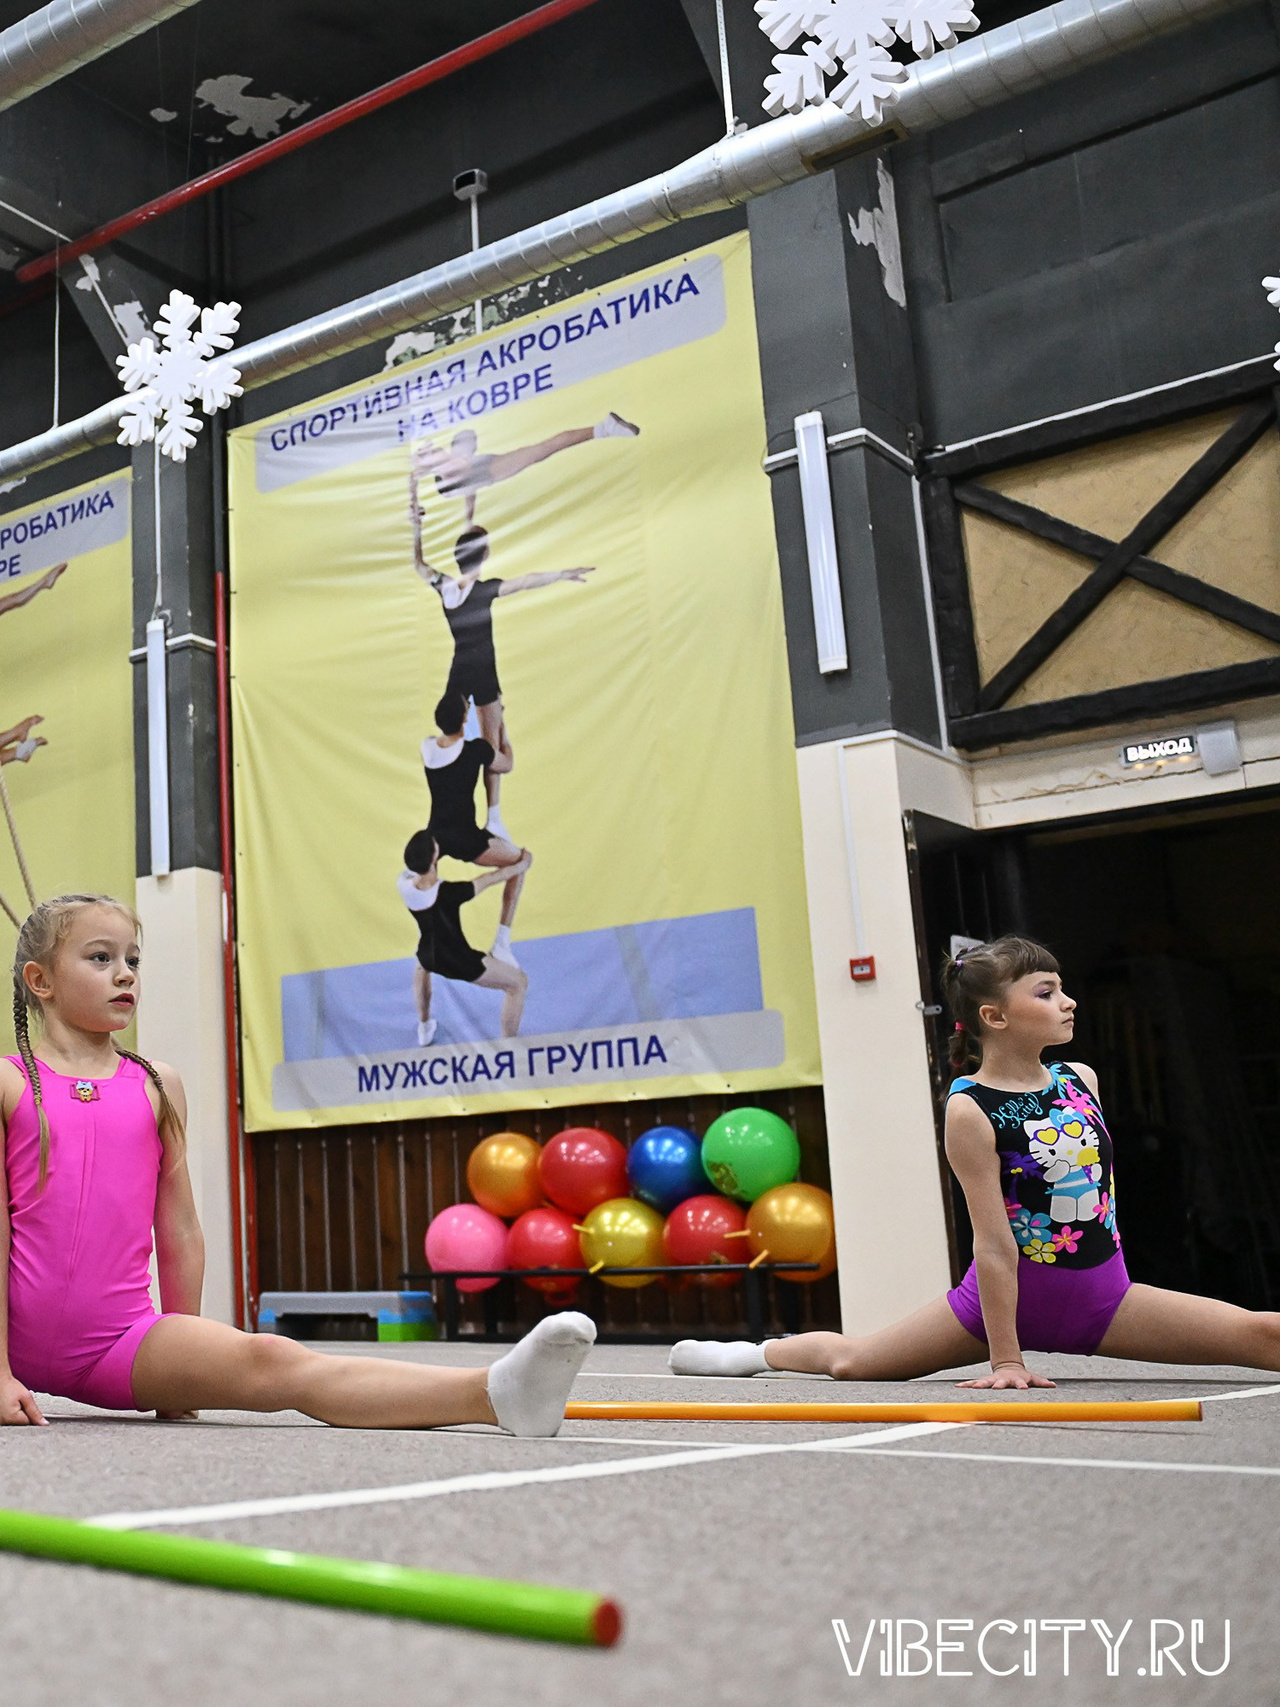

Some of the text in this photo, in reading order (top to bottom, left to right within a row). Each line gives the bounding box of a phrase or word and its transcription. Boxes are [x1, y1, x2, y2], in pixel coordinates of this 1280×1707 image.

[269, 271, 700, 453] СПОРТИВНАЯ АКРОБАТИКА
[397, 363, 554, 443] НА КОВРЕ
[1127, 737, 1192, 762] ВЫХОД
[357, 1034, 668, 1093] МУЖСКАЯ ГРУППА
